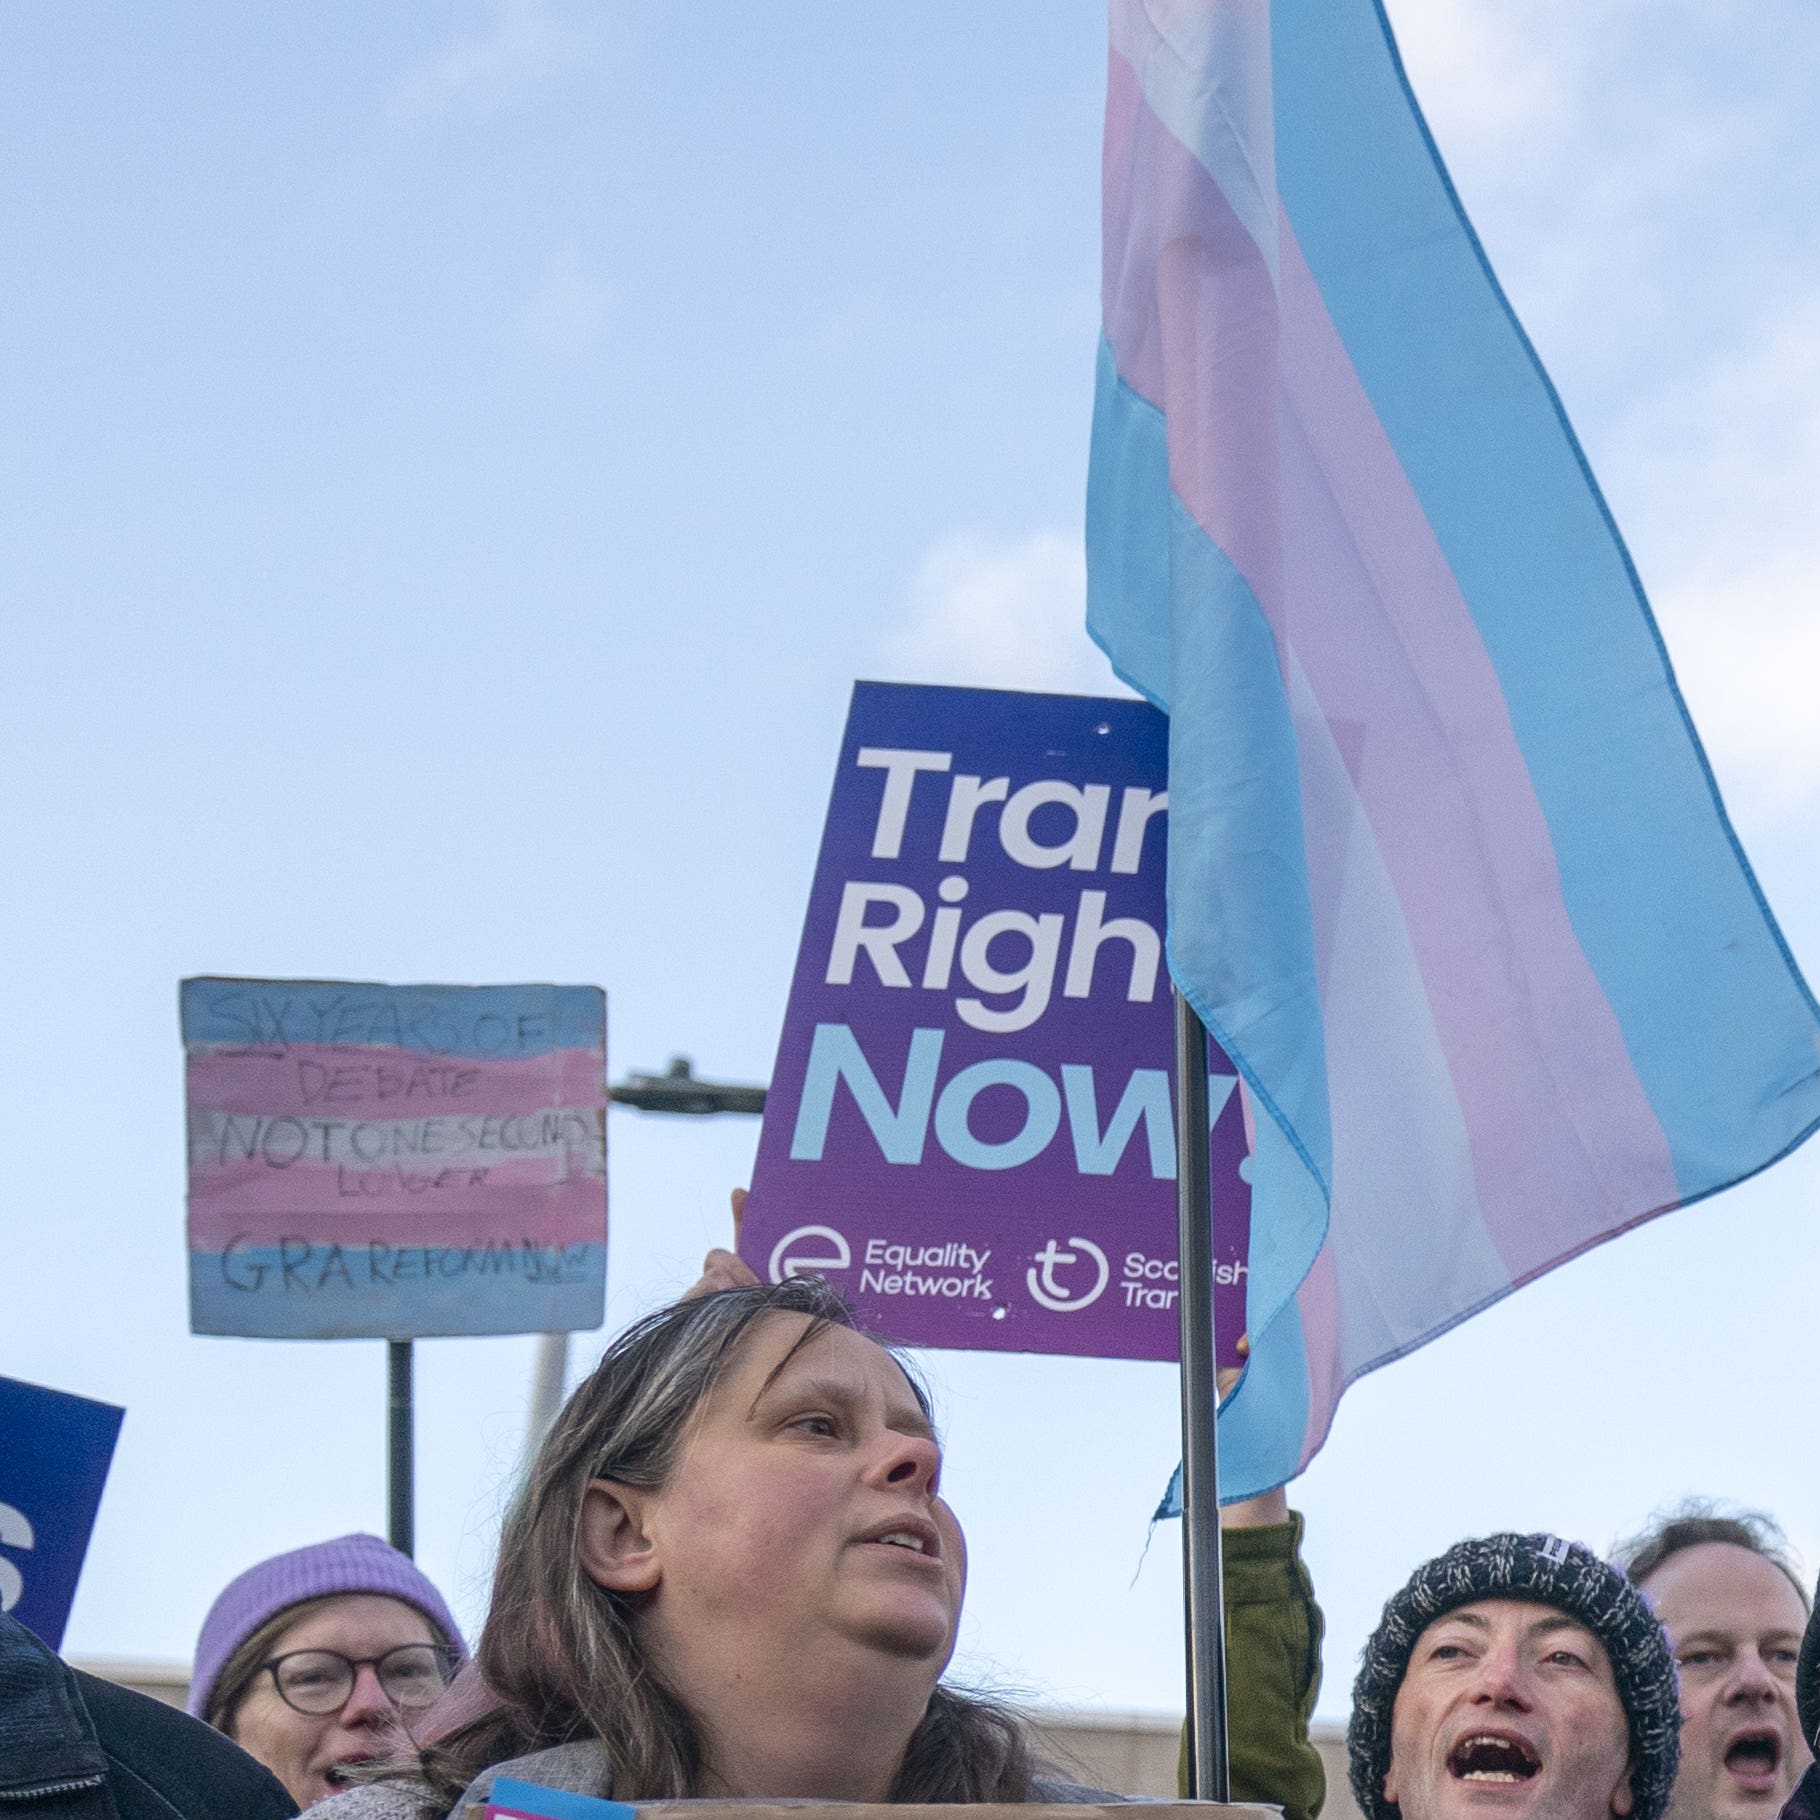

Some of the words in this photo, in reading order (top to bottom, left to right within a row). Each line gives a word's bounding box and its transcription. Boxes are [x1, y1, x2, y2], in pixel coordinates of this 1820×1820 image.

[825, 877, 1174, 1033] Righ
[311, 993, 462, 1050] YEARS
[472, 1013, 544, 1052] OF
[297, 1059, 482, 1105] DEBATE
[218, 1113, 345, 1169] NOT
[350, 1116, 445, 1161] ONE
[457, 1113, 590, 1154] SECOND
[337, 1164, 490, 1197] LONGER
[220, 1231, 355, 1293] GRA
[368, 1236, 516, 1286] REFORM
[864, 1239, 991, 1274] Equality
[1124, 1252, 1249, 1286] Scoish
[860, 1269, 993, 1300] Network
